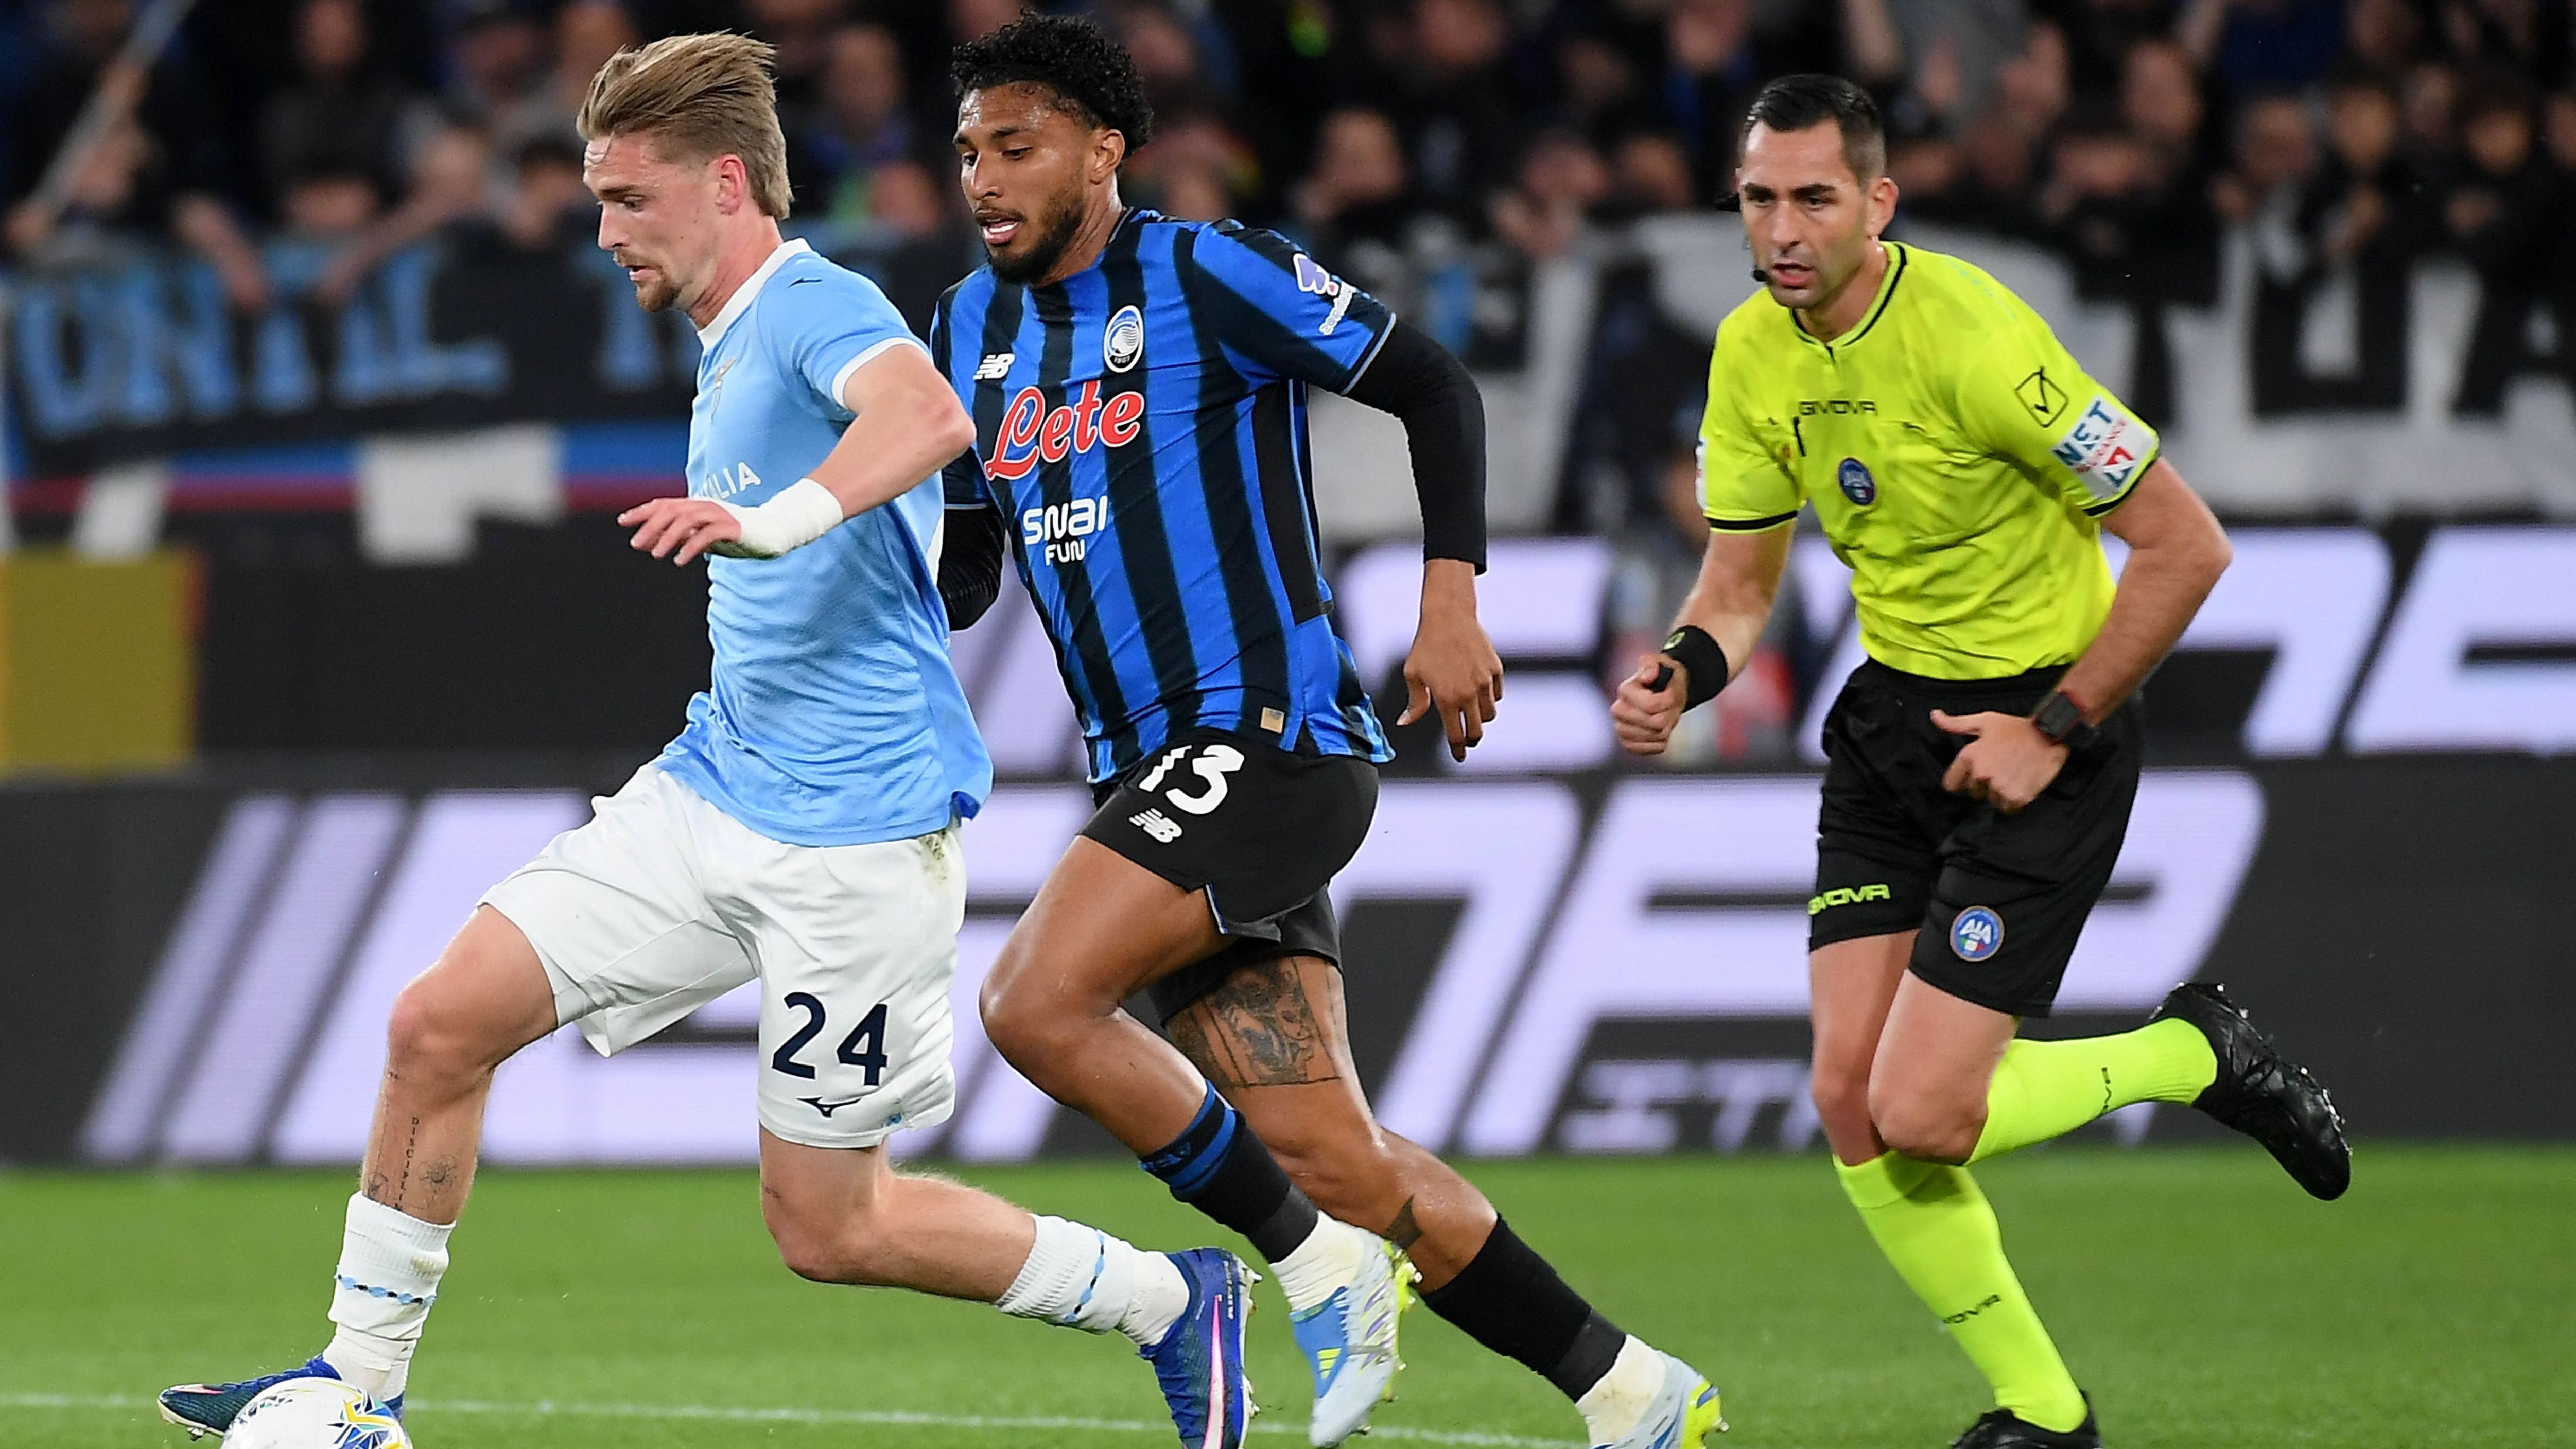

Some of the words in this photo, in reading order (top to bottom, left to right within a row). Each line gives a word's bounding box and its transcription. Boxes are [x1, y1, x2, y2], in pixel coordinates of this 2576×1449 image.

[984, 379, 1145, 481] Lete
[1798, 399, 1878, 416] GIVOVA
[2052, 399, 2112, 466] NET
[1045, 539, 1085, 566] FUN
[1139, 744, 1245, 815] 13
[1959, 918, 1992, 945] AIA
[771, 991, 888, 1086] 24
